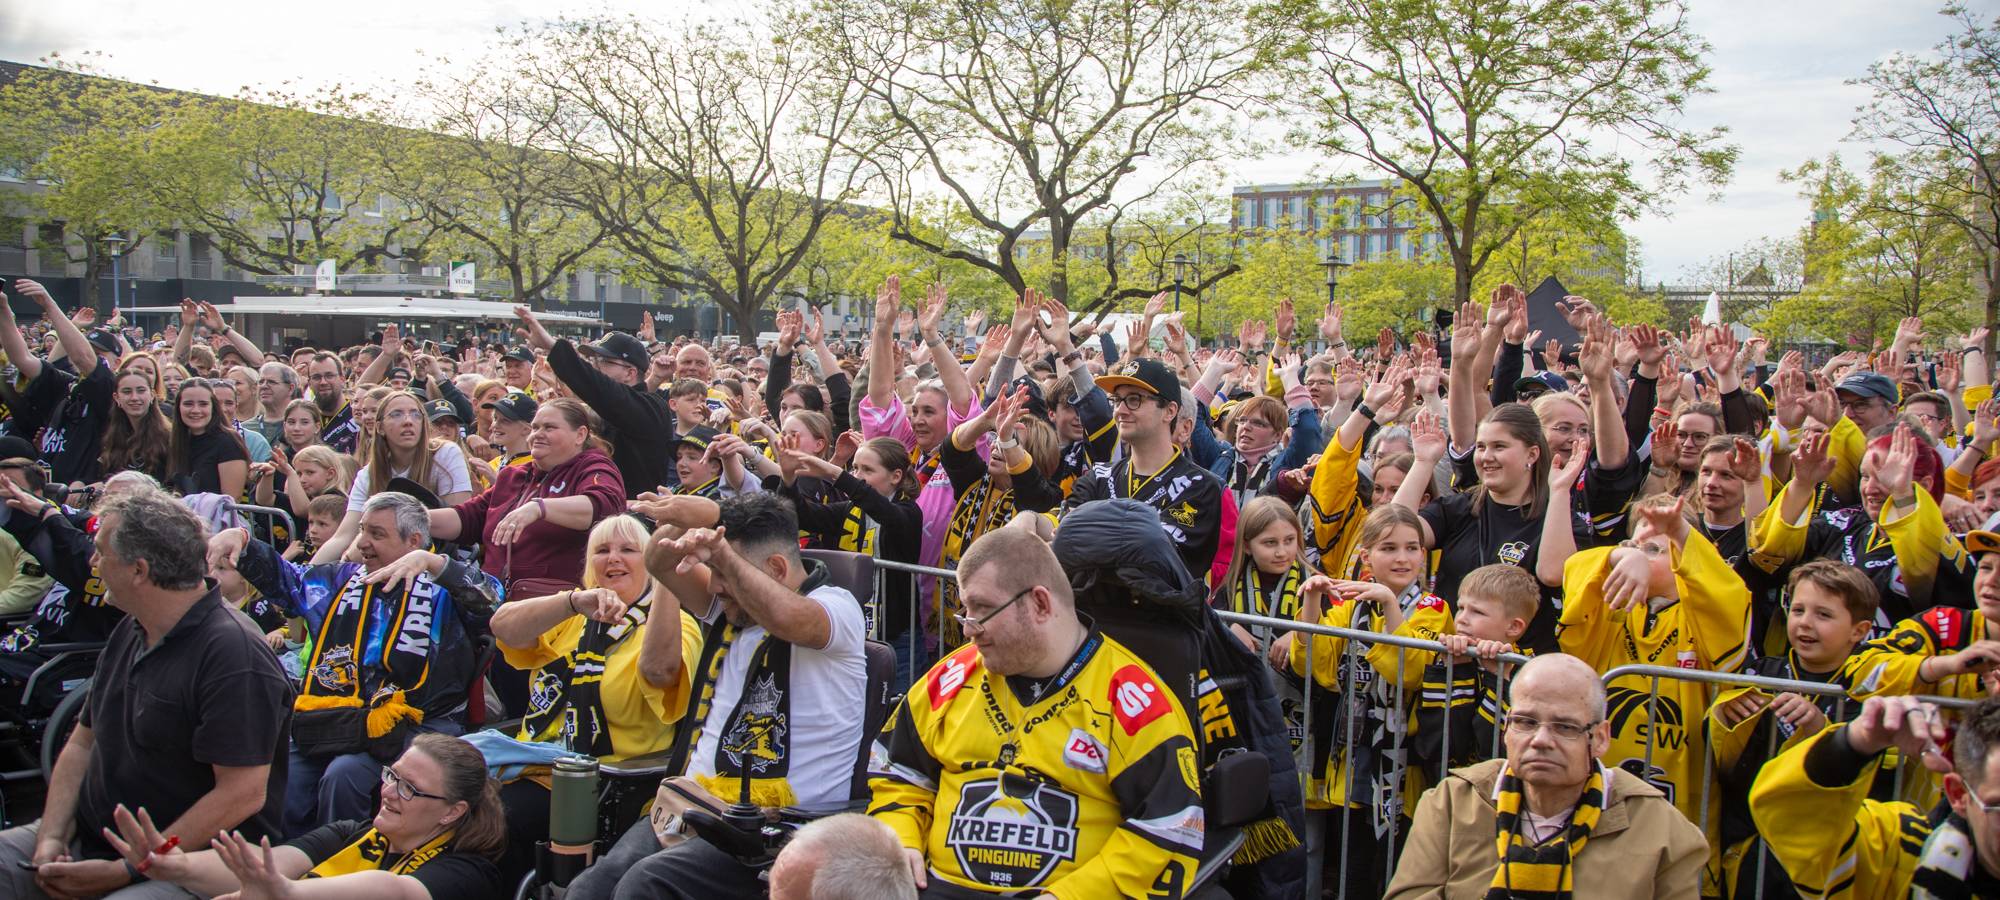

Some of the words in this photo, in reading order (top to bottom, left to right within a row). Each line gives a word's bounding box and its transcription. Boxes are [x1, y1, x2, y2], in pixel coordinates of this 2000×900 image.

[655, 312, 674, 323] Jeep
[951, 818, 1070, 850] KREFELD
[968, 847, 1042, 869] PINGUINE
[990, 871, 1012, 882] 1936
